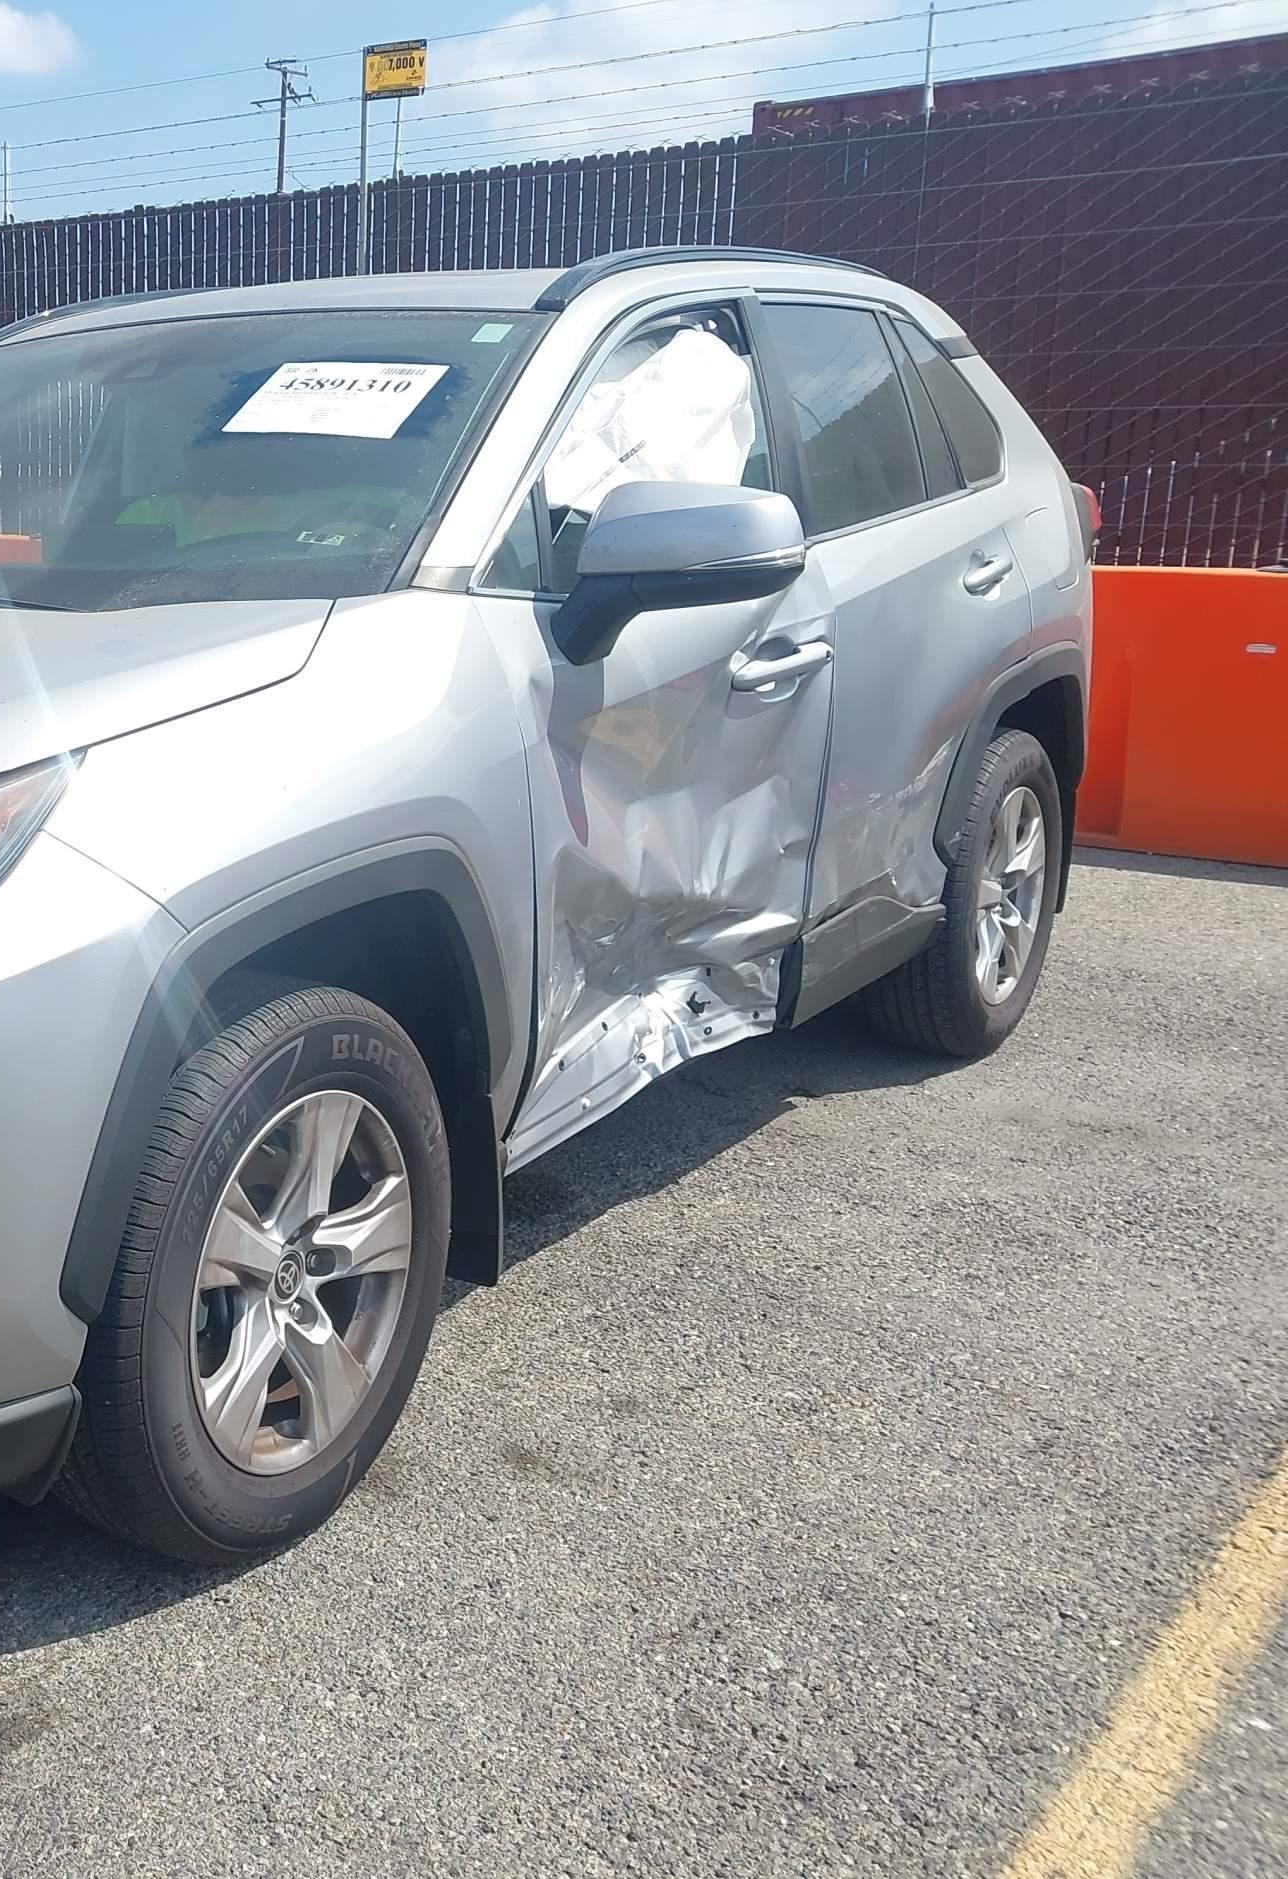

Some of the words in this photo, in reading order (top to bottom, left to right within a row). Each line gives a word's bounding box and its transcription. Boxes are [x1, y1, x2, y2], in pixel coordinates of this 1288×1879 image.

[388, 56, 415, 72] 7,000
[419, 55, 425, 67] V
[280, 377, 412, 394] 45891310
[182, 1104, 248, 1247] 225/65R17
